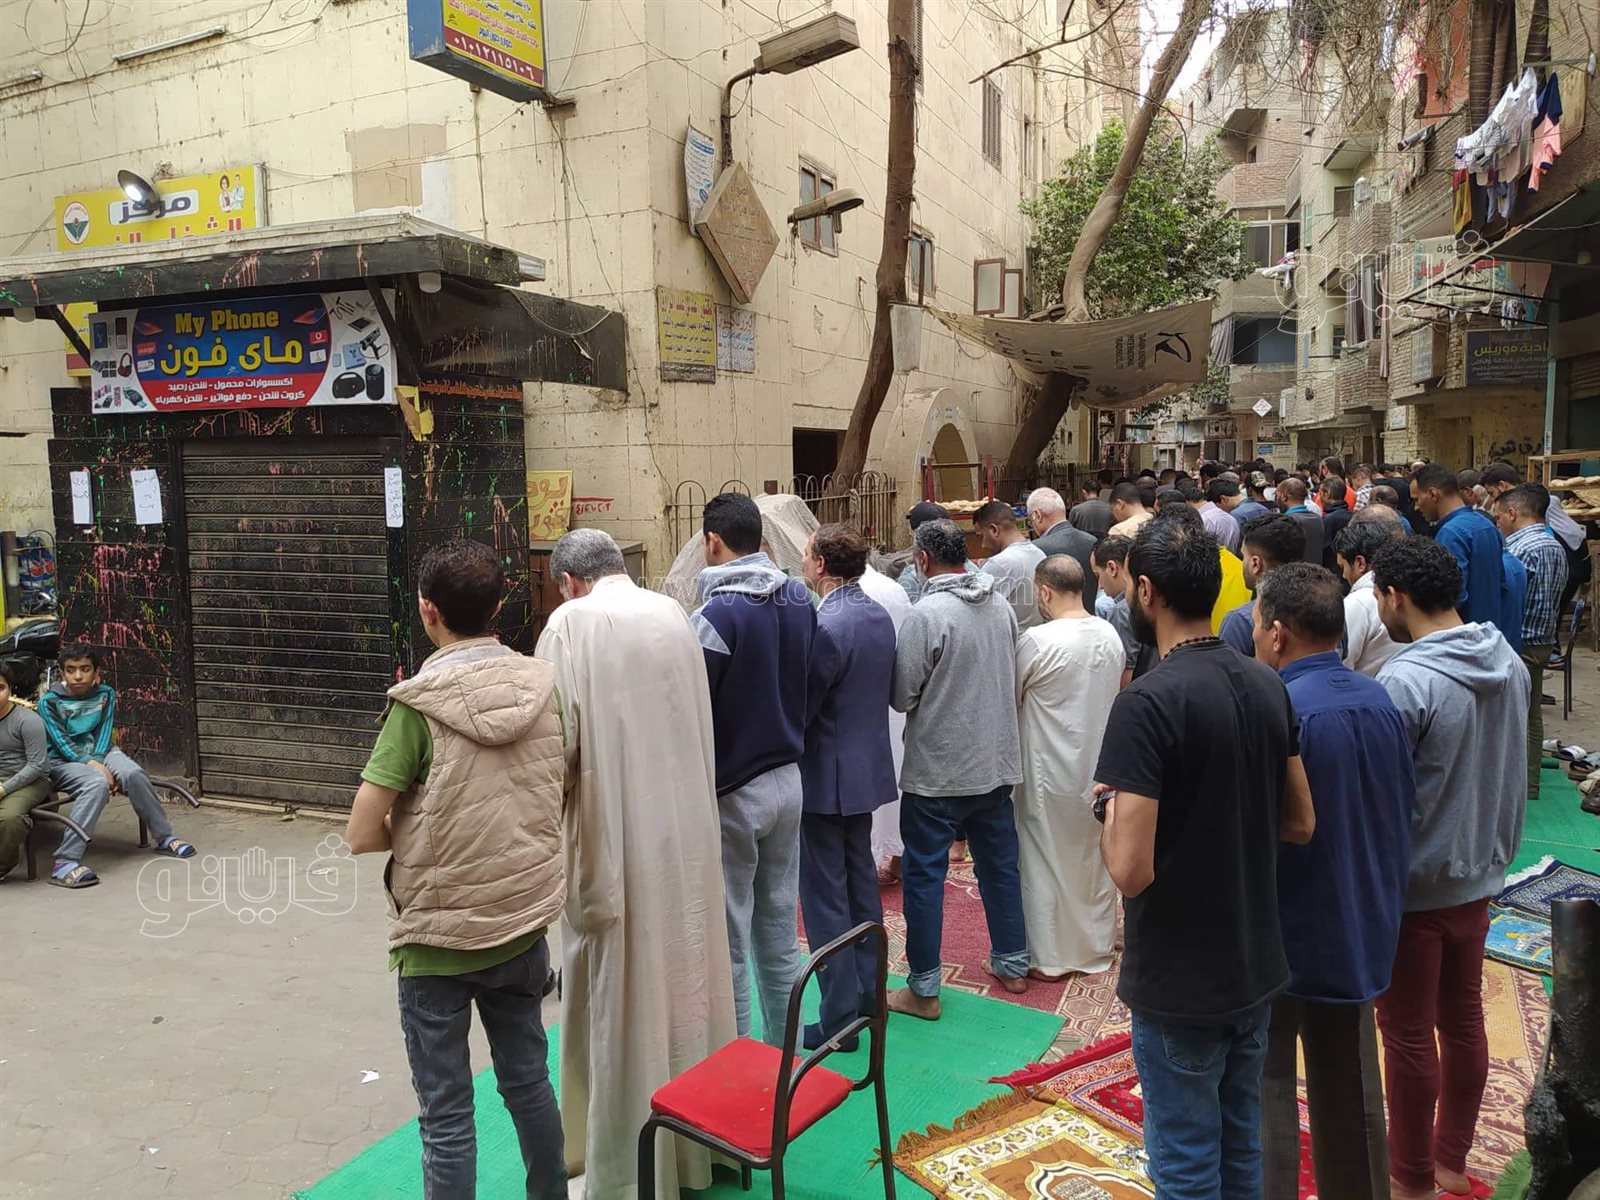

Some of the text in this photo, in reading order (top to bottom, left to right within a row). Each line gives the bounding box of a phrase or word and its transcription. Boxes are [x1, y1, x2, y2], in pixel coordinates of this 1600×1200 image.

[175, 309, 280, 337] My Phone
[160, 336, 228, 376] فون
[168, 383, 188, 392] رصيد
[188, 381, 208, 391] شحن
[214, 381, 244, 390] محمول
[155, 394, 182, 405] كهرباء
[184, 393, 203, 404] شحن
[209, 393, 234, 403] فواتير
[235, 393, 252, 402] دفع
[259, 391, 279, 401] شحن
[280, 390, 305, 400] كروت
